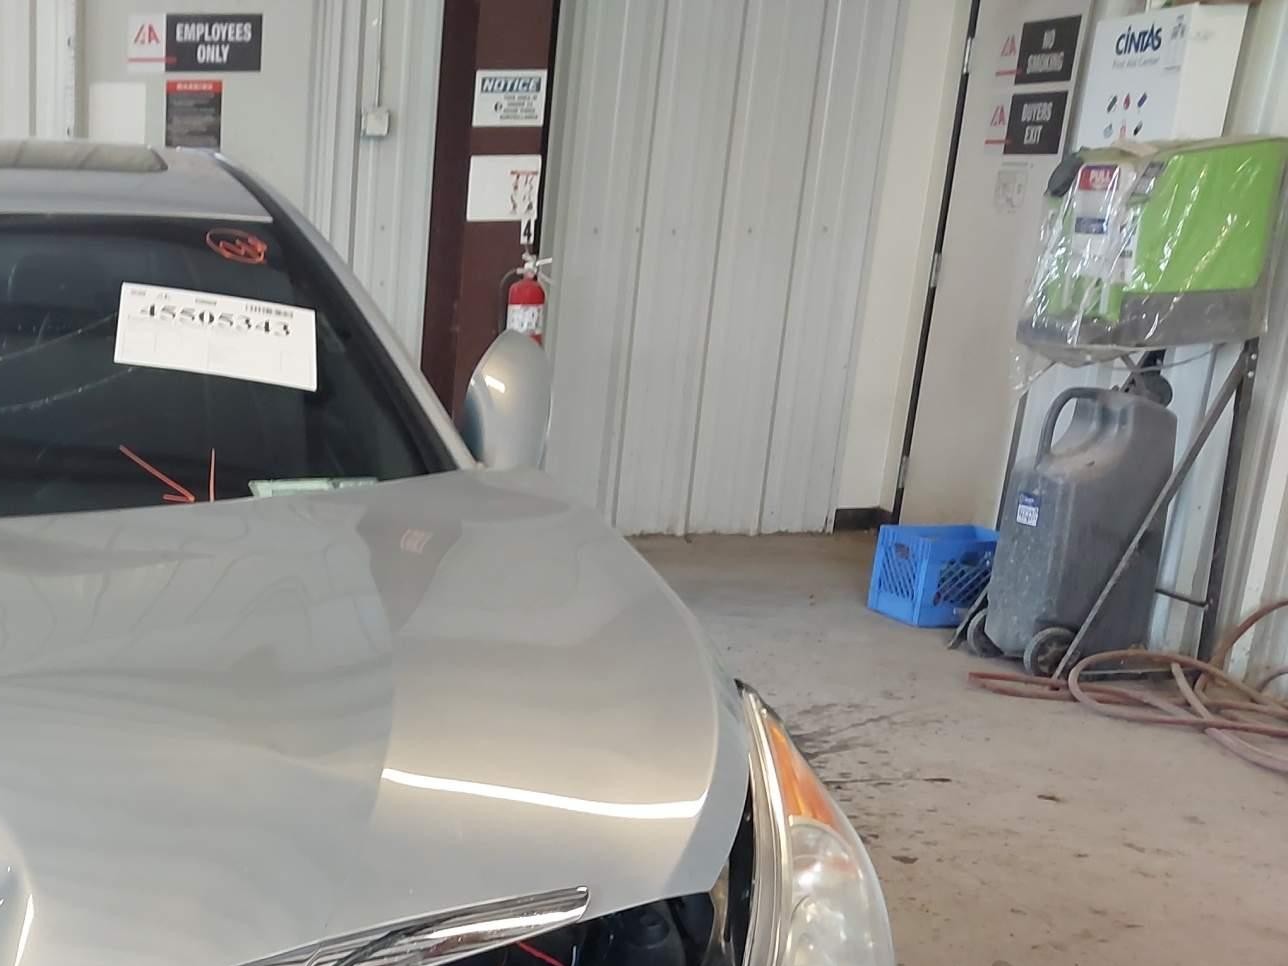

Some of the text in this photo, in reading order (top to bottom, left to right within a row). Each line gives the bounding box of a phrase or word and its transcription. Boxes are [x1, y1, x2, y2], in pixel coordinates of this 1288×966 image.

[175, 22, 252, 42] EMPLOYEES
[196, 44, 230, 63] ONLY
[481, 77, 540, 93] NOTICE
[1021, 101, 1053, 122] BUYERS
[1023, 125, 1043, 145] EXIT
[523, 219, 532, 243] 4
[140, 303, 291, 337] 45505343
